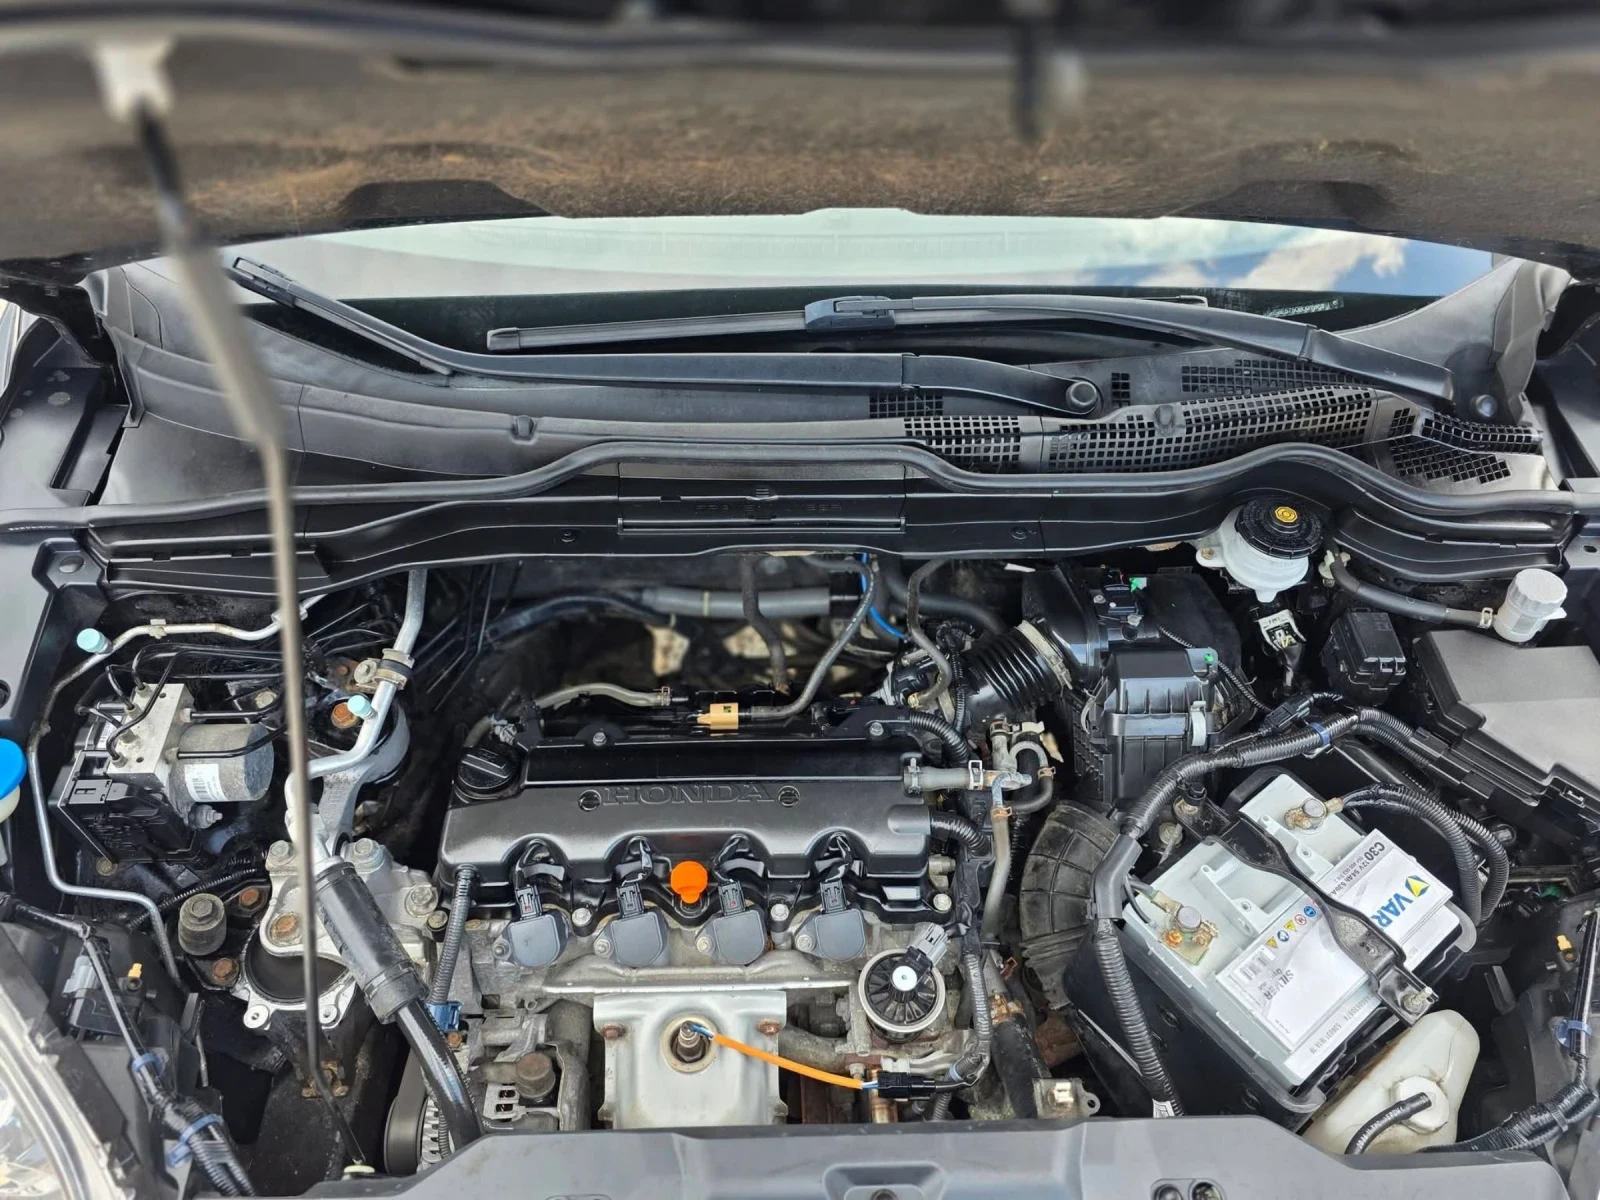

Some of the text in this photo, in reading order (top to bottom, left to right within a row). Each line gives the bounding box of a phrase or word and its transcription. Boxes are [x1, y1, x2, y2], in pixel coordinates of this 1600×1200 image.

[603, 783, 774, 806] HONDA
[1364, 841, 1385, 861] C30
[1359, 859, 1370, 871] 12V
[1370, 892, 1414, 928] VAR
[1263, 968, 1295, 1001] SILVER
